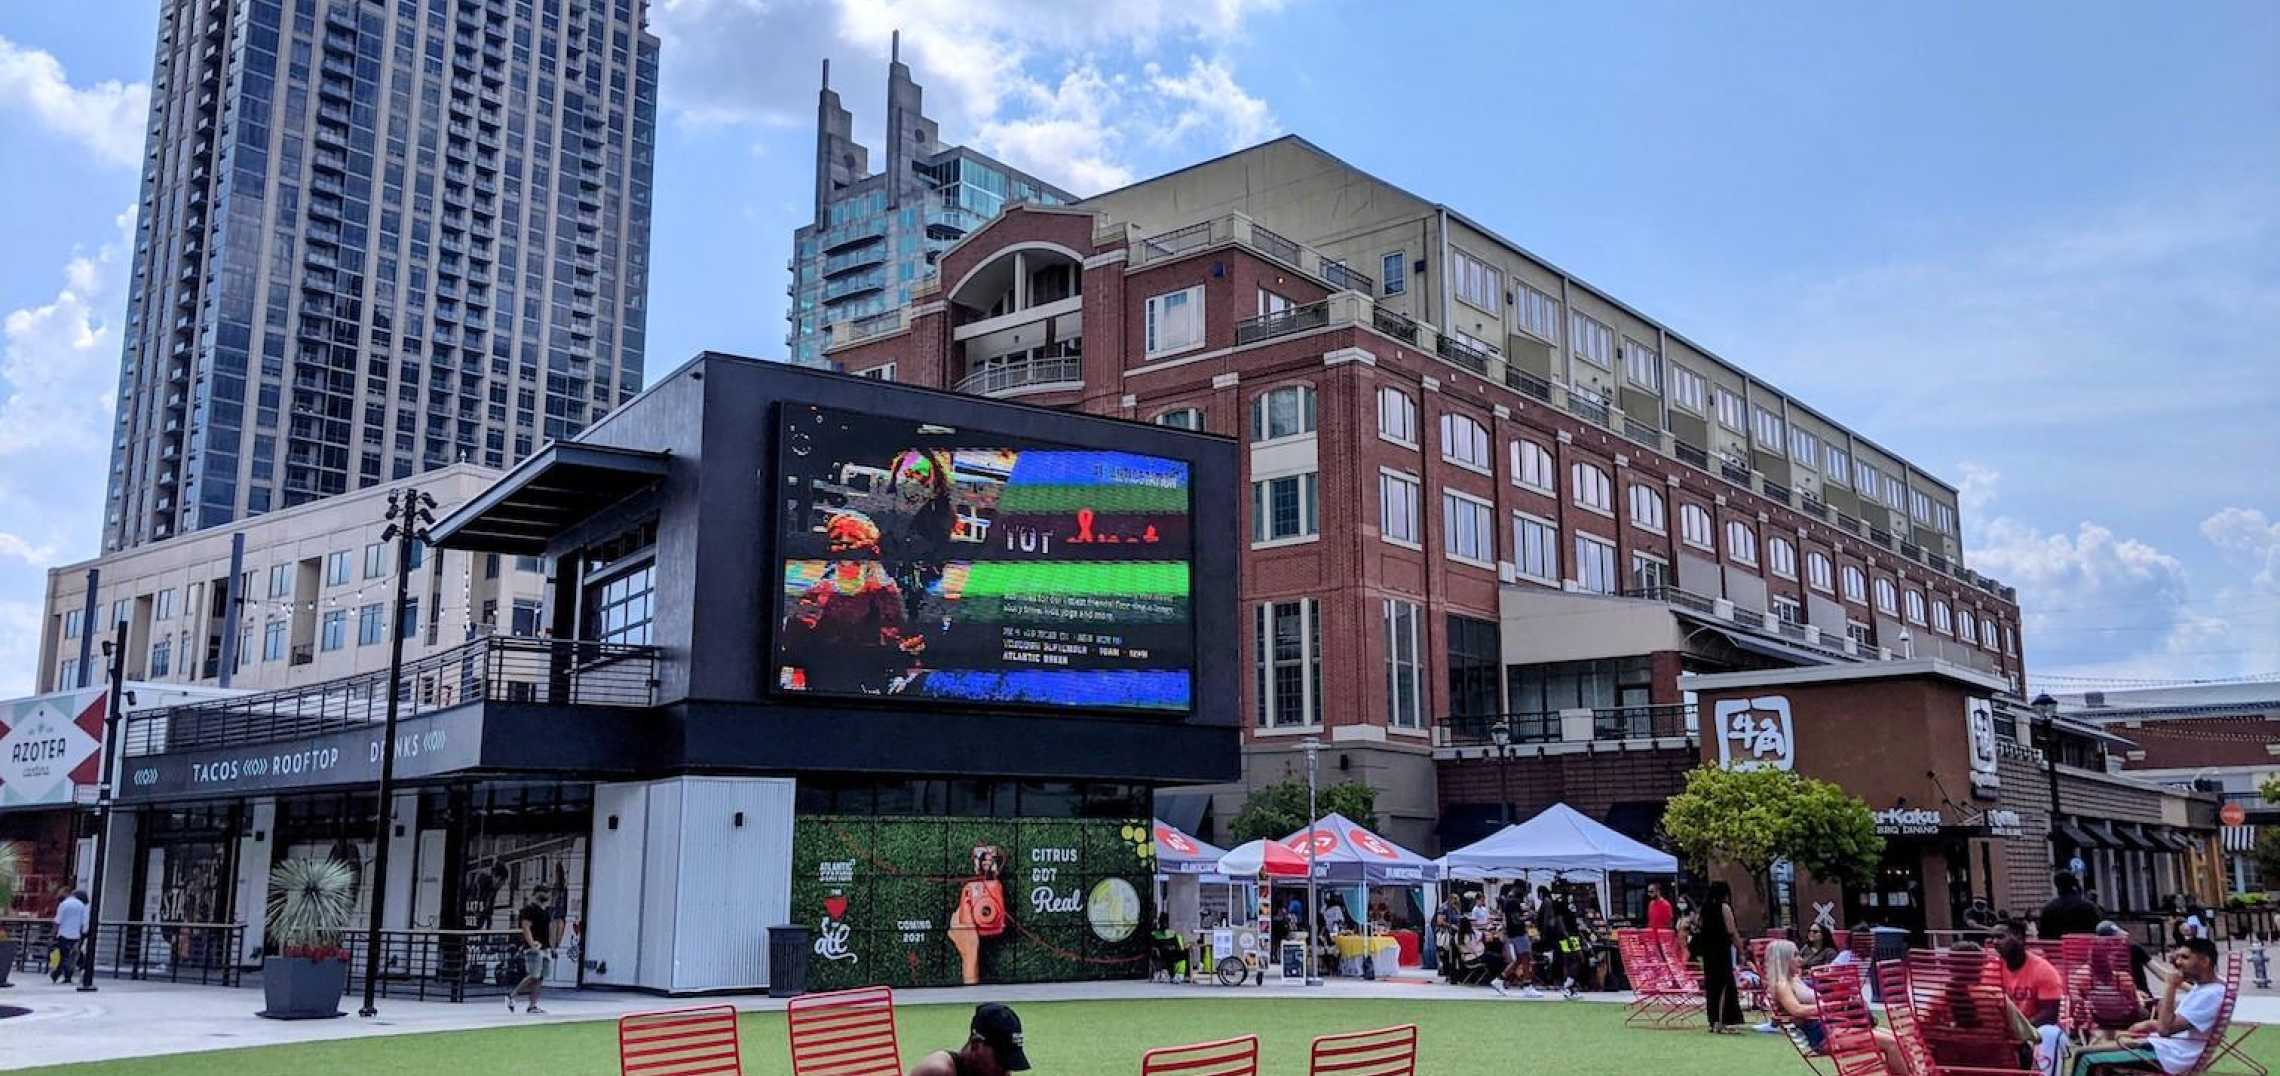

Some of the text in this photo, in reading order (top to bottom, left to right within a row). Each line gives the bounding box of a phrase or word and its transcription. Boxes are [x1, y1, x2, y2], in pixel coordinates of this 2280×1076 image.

[12, 737, 67, 764] AZOTEA
[192, 738, 419, 784] TACOS ROOFTOP DNKS
[1902, 825, 1939, 836] DINING
[1031, 848, 1078, 862] CITRUS
[1031, 867, 1058, 883] GOT
[1030, 885, 1083, 913] Real
[896, 919, 933, 931] COMING
[902, 932, 926, 943] 2021
